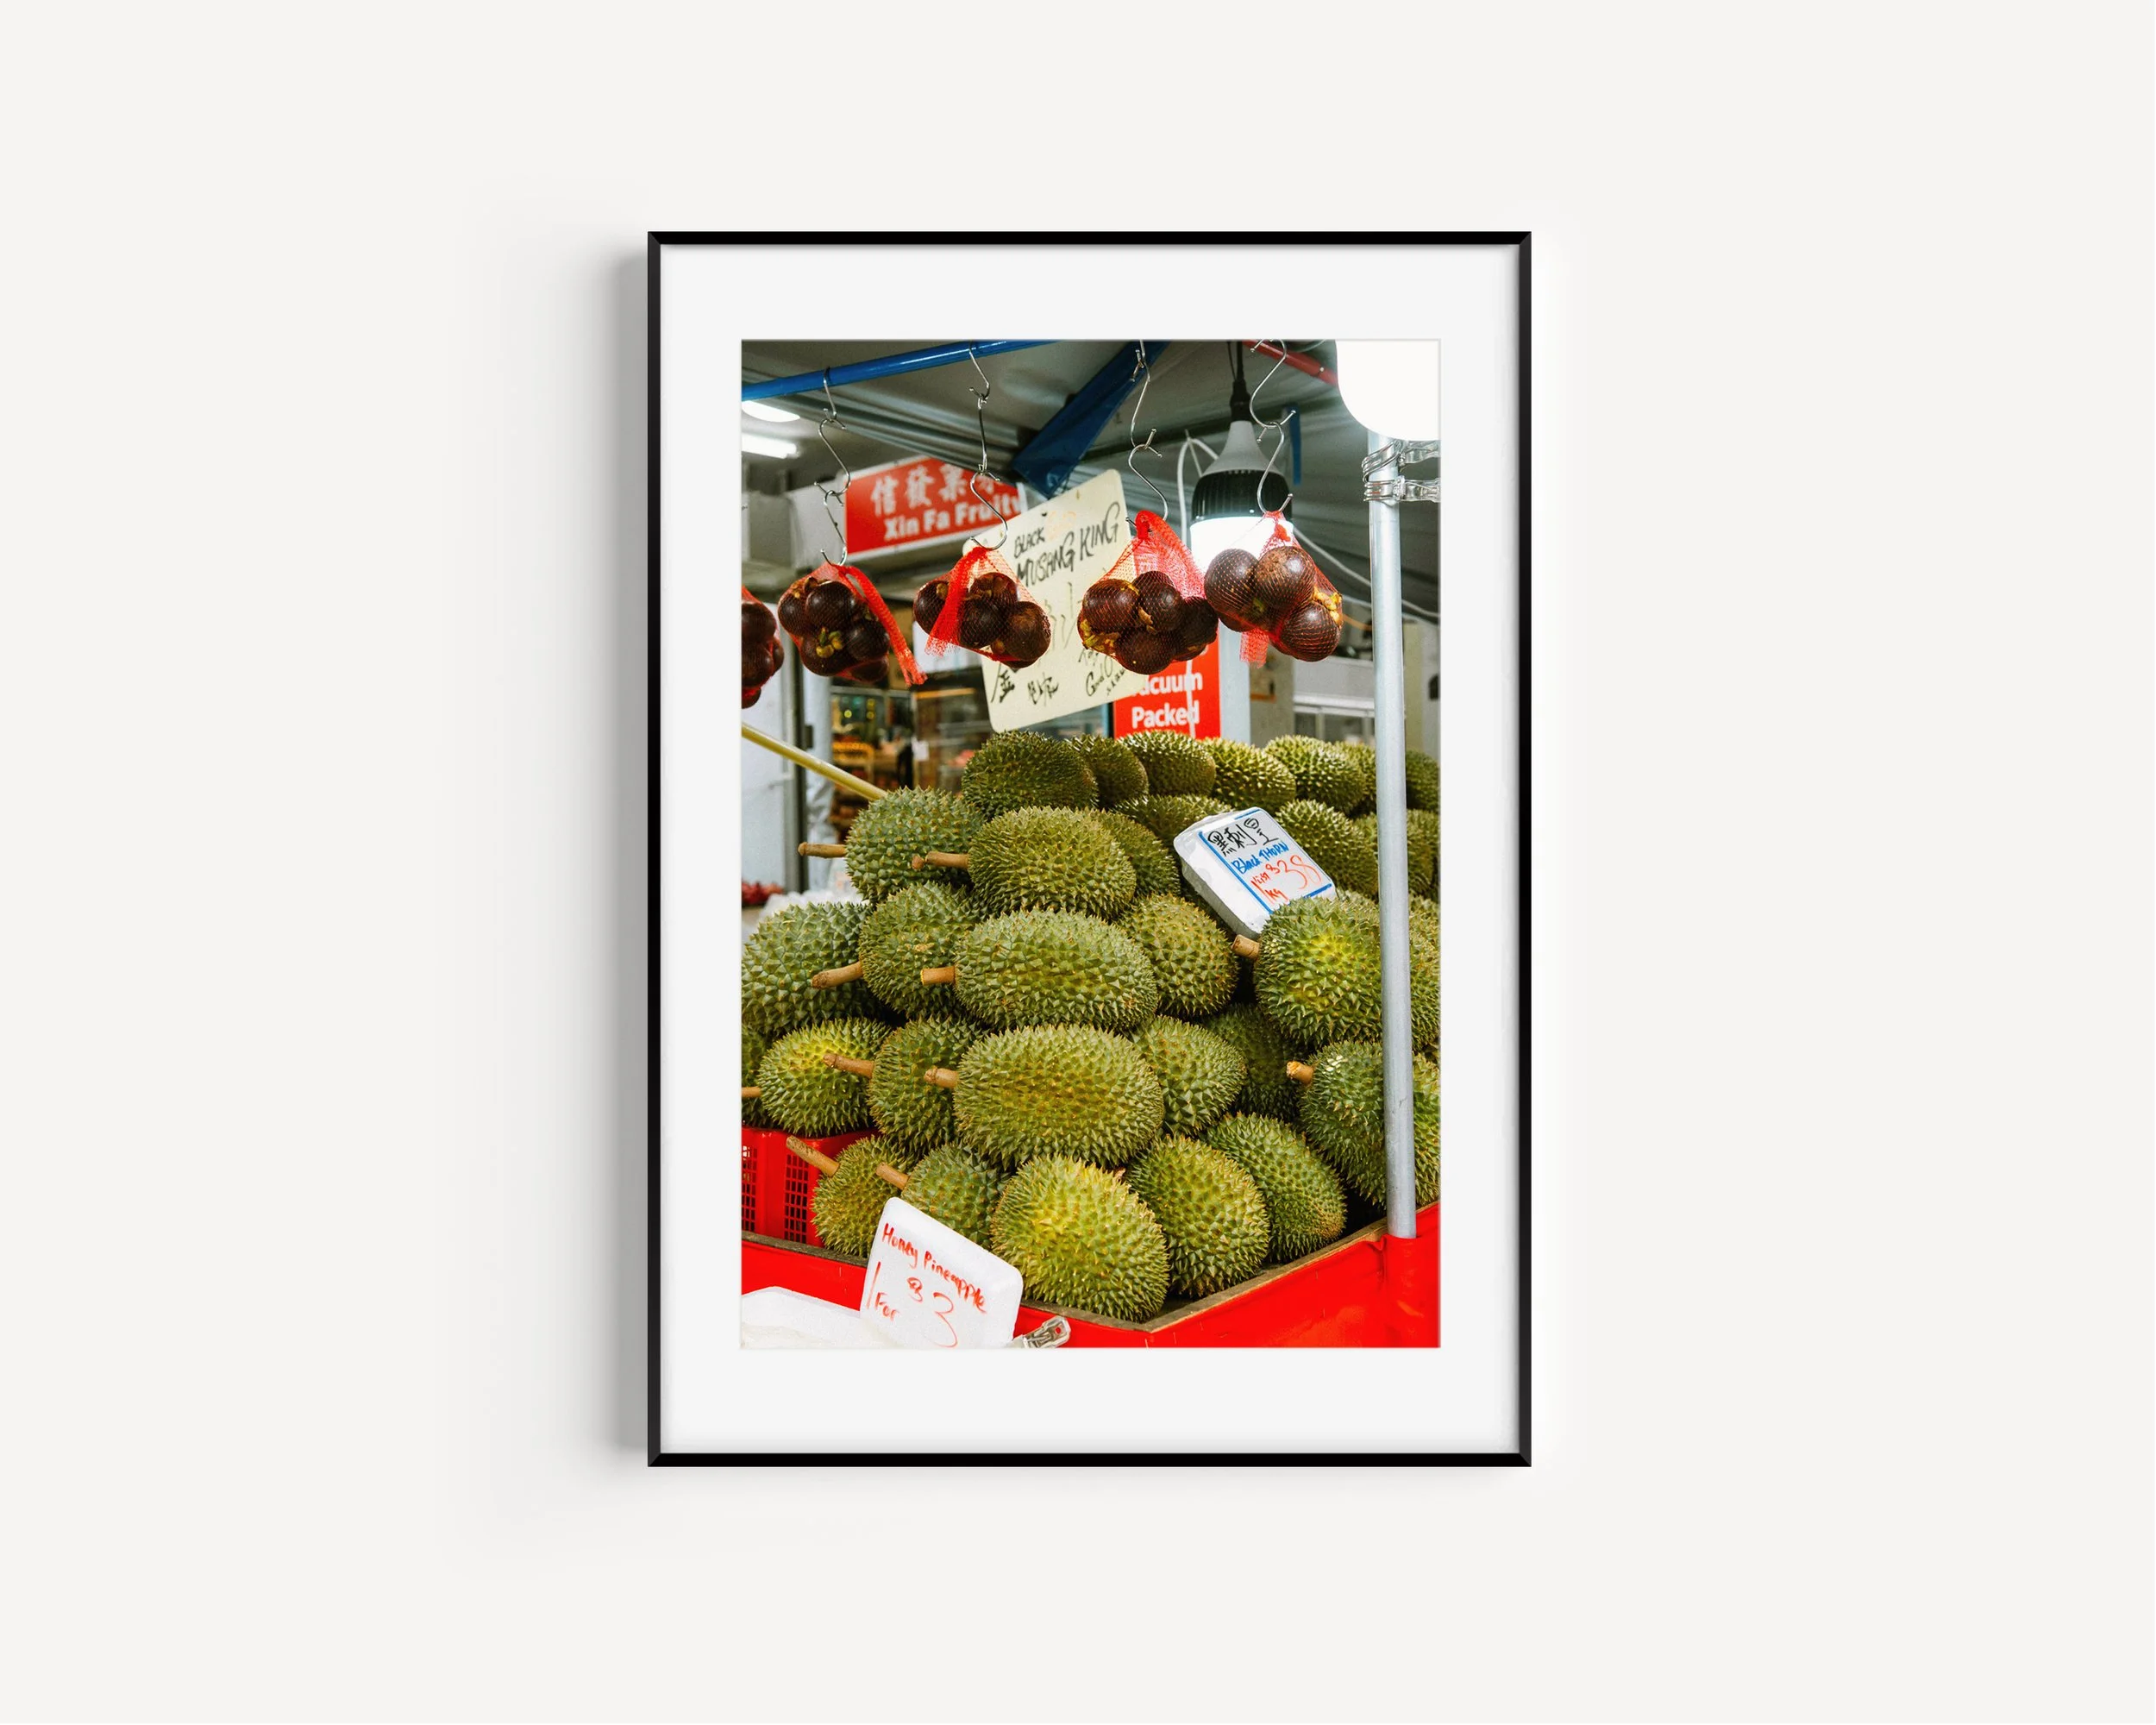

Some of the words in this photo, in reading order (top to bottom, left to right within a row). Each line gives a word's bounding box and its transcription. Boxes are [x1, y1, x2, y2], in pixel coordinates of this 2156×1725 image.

[883, 517, 920, 541] Xin
[924, 508, 950, 532] Fa
[1013, 527, 1046, 559] BLACK
[1017, 530, 1076, 587] MUSANG
[1079, 501, 1121, 561] KING
[1131, 699, 1200, 729] Packed
[1231, 854, 1263, 874] Black
[881, 1222, 918, 1270] Honey
[924, 1250, 987, 1315] Pineapple
